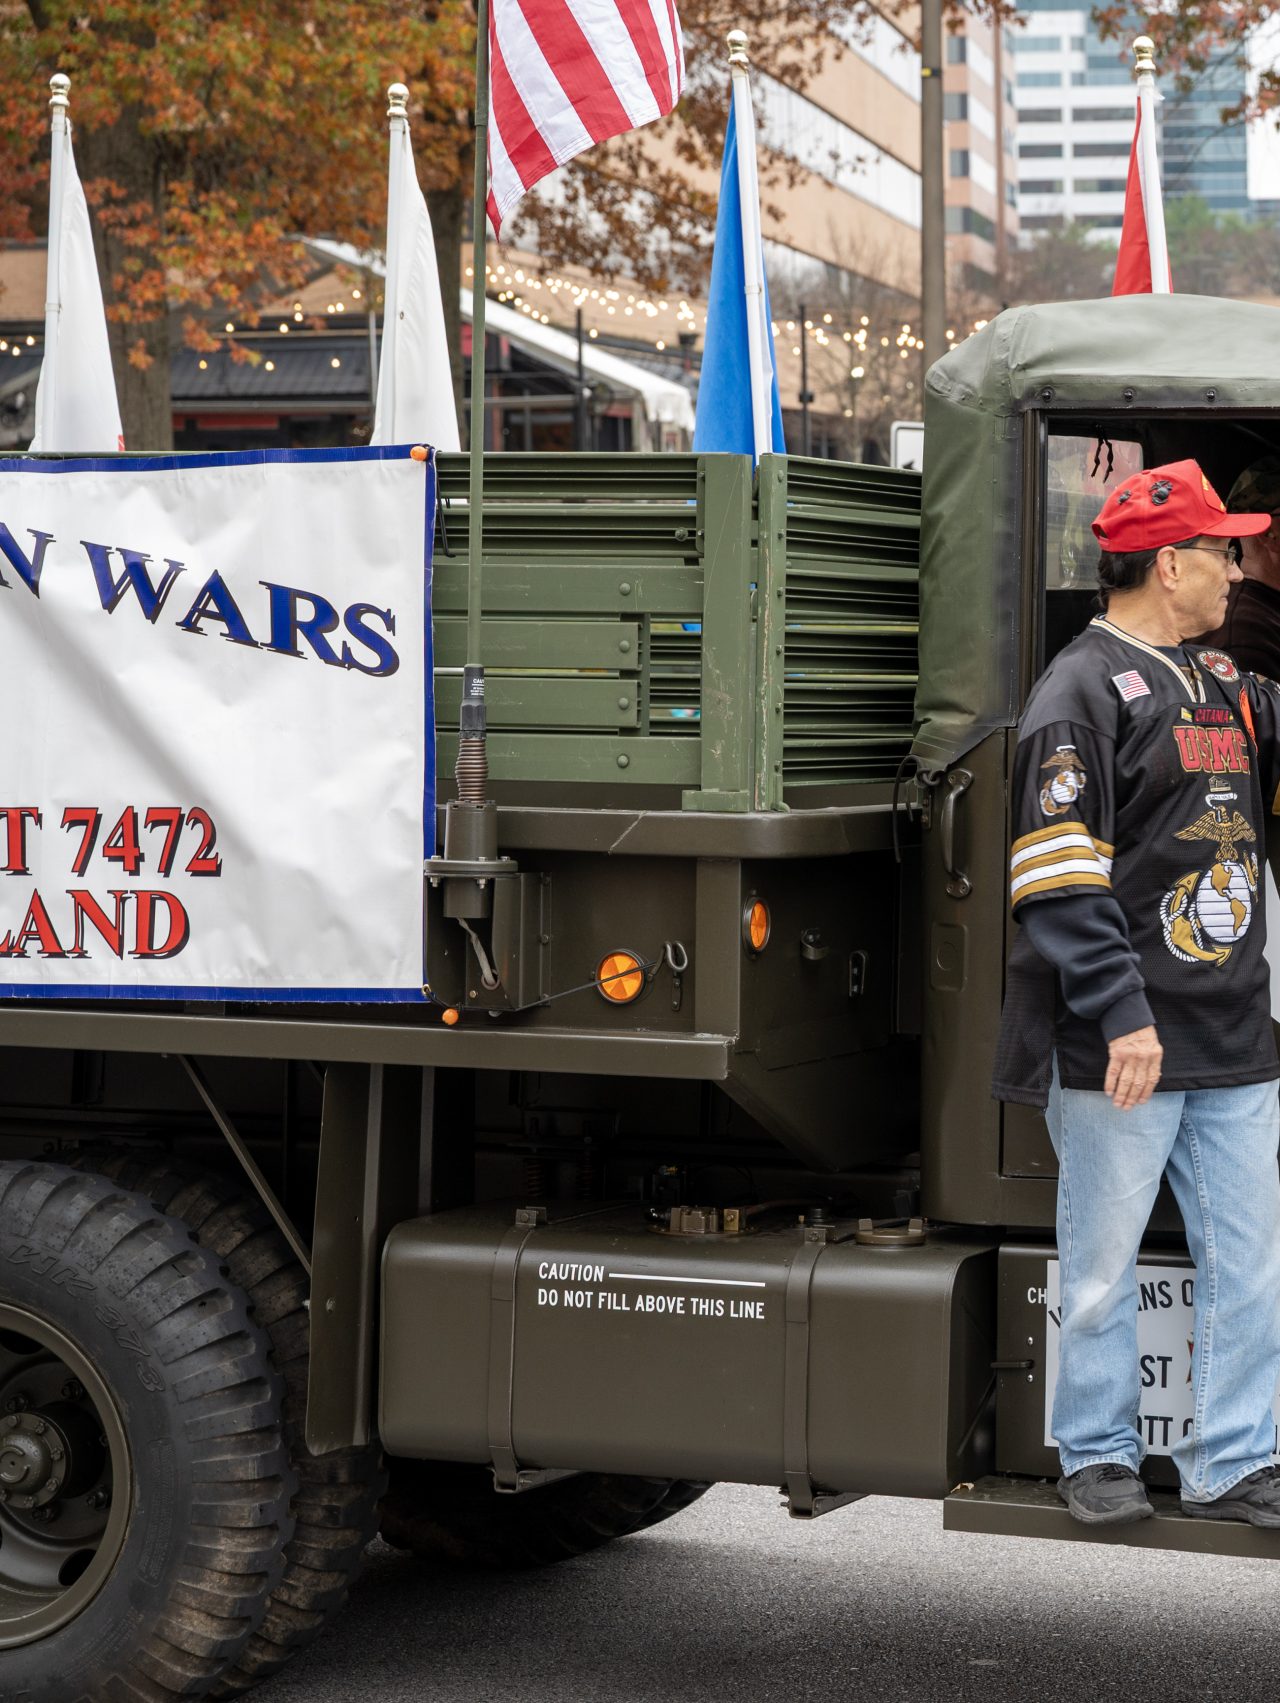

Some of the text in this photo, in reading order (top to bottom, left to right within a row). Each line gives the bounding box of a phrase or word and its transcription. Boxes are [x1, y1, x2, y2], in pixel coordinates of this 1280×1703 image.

[80, 540, 400, 677] WARS
[1173, 725, 1250, 774] USMC
[60, 806, 222, 877] 7472
[0, 888, 190, 960] AND
[538, 1262, 604, 1283] CAUTION
[538, 1288, 765, 1320] DO NOT FILL ABOVE THIS LINE
[1140, 1354, 1172, 1388] ST
